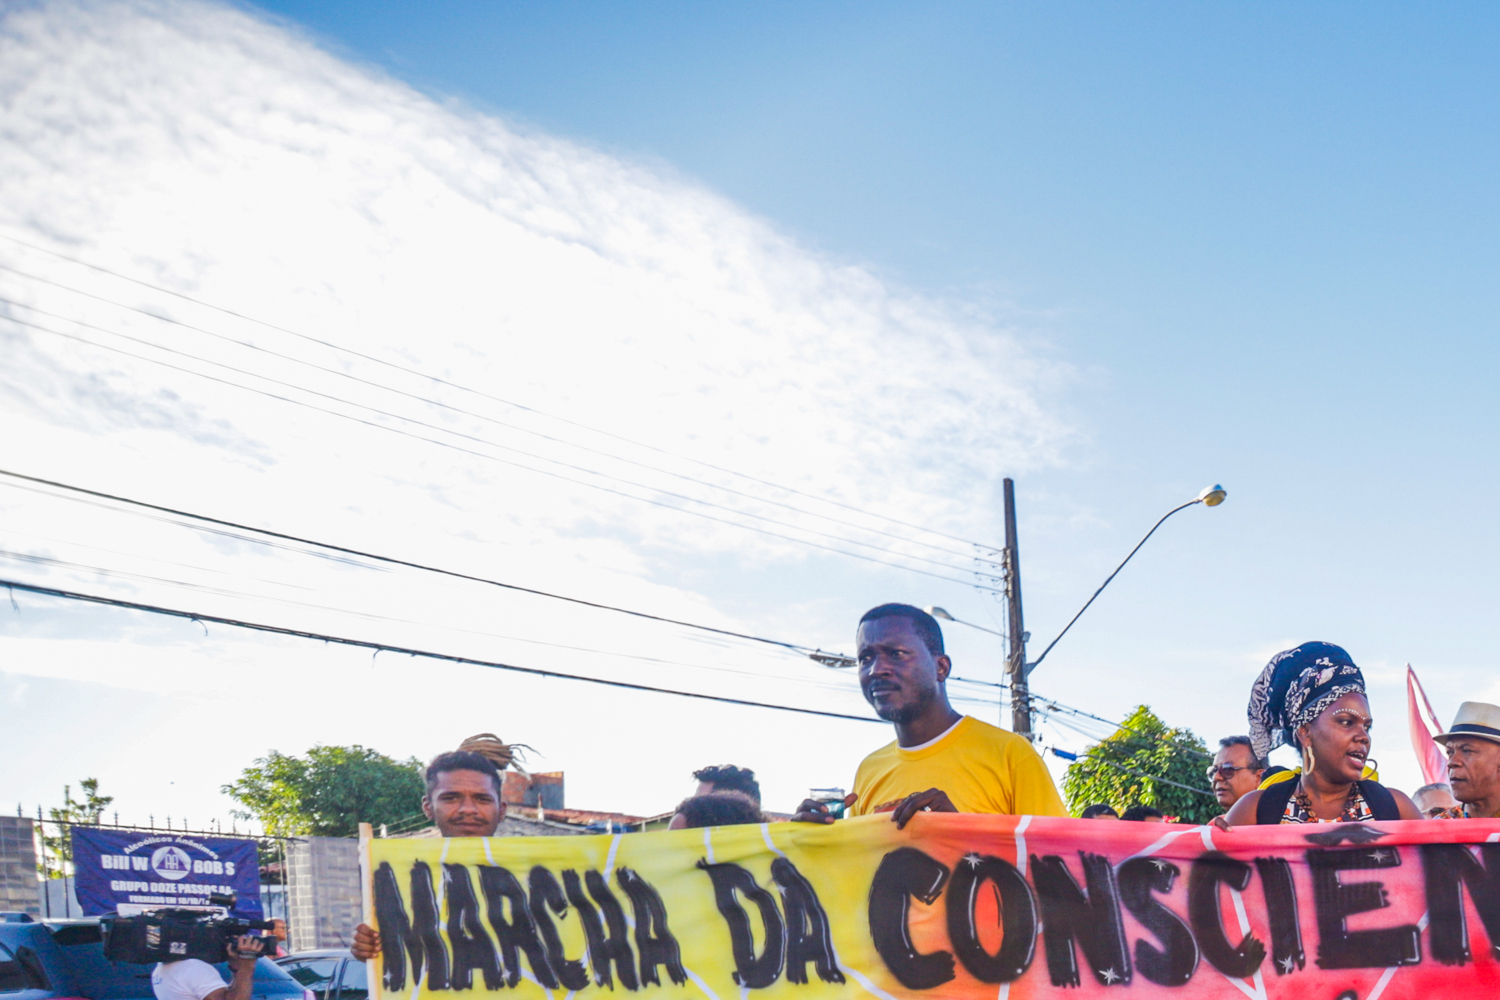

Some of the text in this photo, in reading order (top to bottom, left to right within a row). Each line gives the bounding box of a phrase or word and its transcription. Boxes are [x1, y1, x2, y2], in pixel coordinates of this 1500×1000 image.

[101, 854, 236, 876] Bill W BOB S
[111, 880, 149, 893] GRUPO
[150, 882, 177, 893] DOZE
[178, 883, 218, 895] PASSOS
[128, 895, 165, 904] FORMADO
[166, 896, 177, 904] EM
[374, 857, 691, 992] MARCHA
[695, 856, 847, 989] DA
